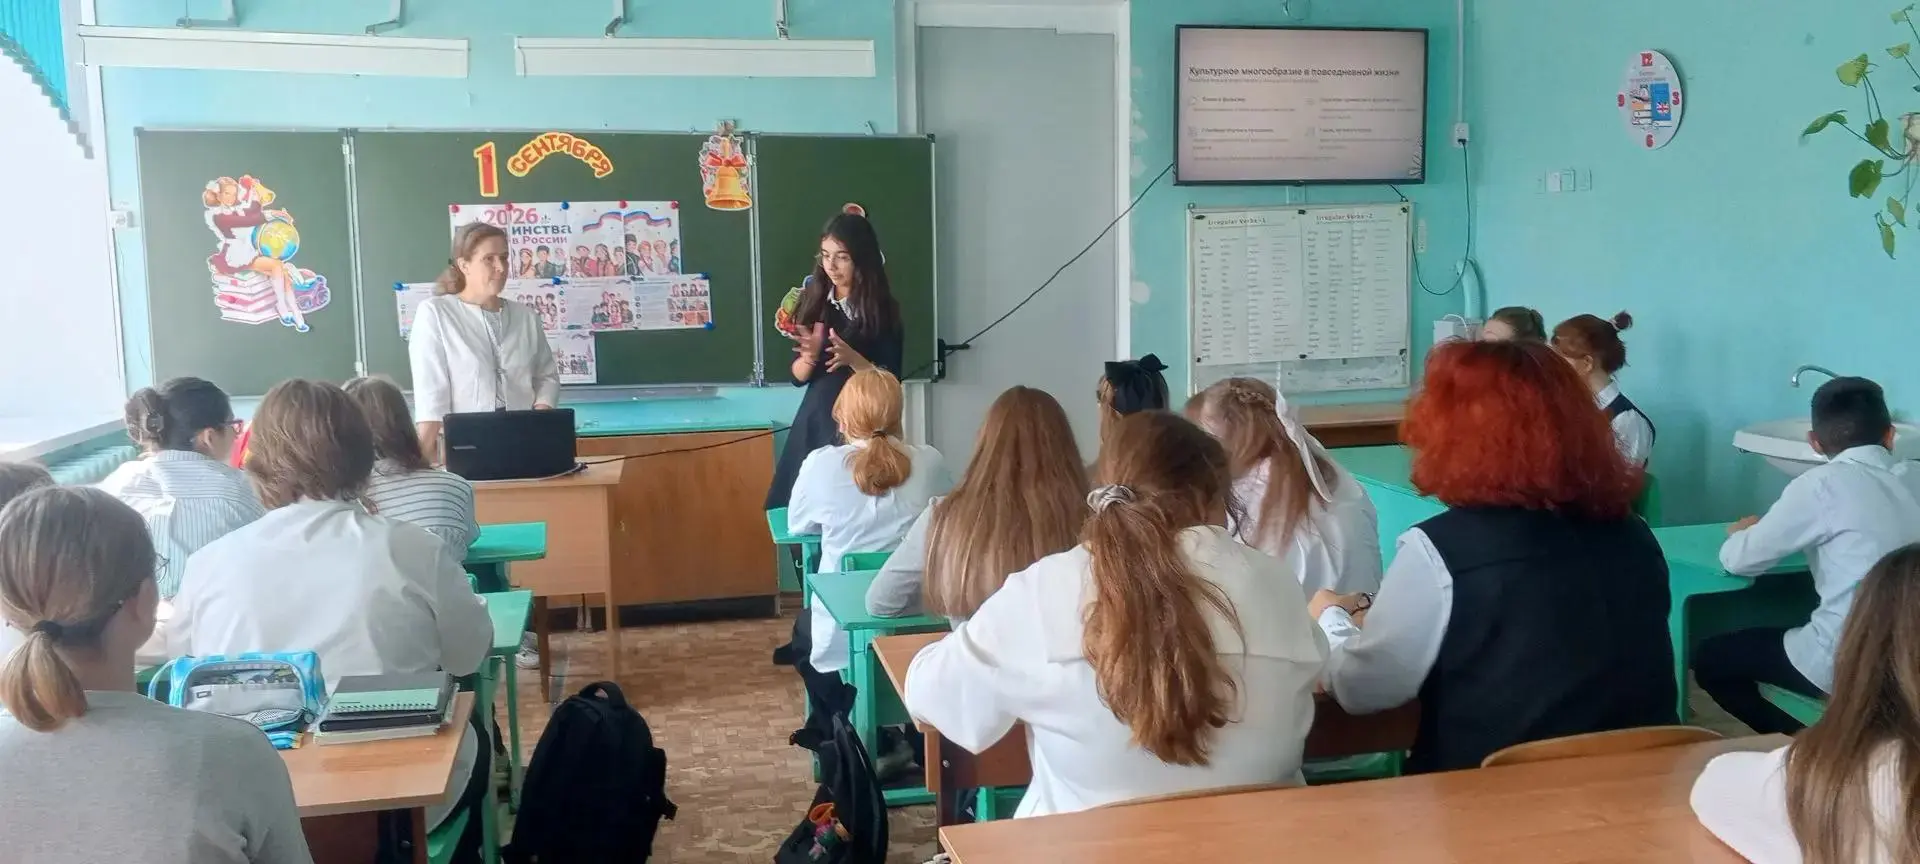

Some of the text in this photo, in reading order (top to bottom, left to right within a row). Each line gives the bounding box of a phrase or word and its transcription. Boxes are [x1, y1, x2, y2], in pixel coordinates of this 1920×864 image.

[1641, 53, 1653, 66] 12
[1189, 66, 1400, 77] Культурное многообразие в повседневной жизни
[1672, 91, 1680, 105] 3
[1646, 134, 1653, 147] 6
[475, 133, 613, 197] 1 СЕНТЯБРЯ
[484, 207, 539, 226] 2026
[522, 235, 568, 245] России
